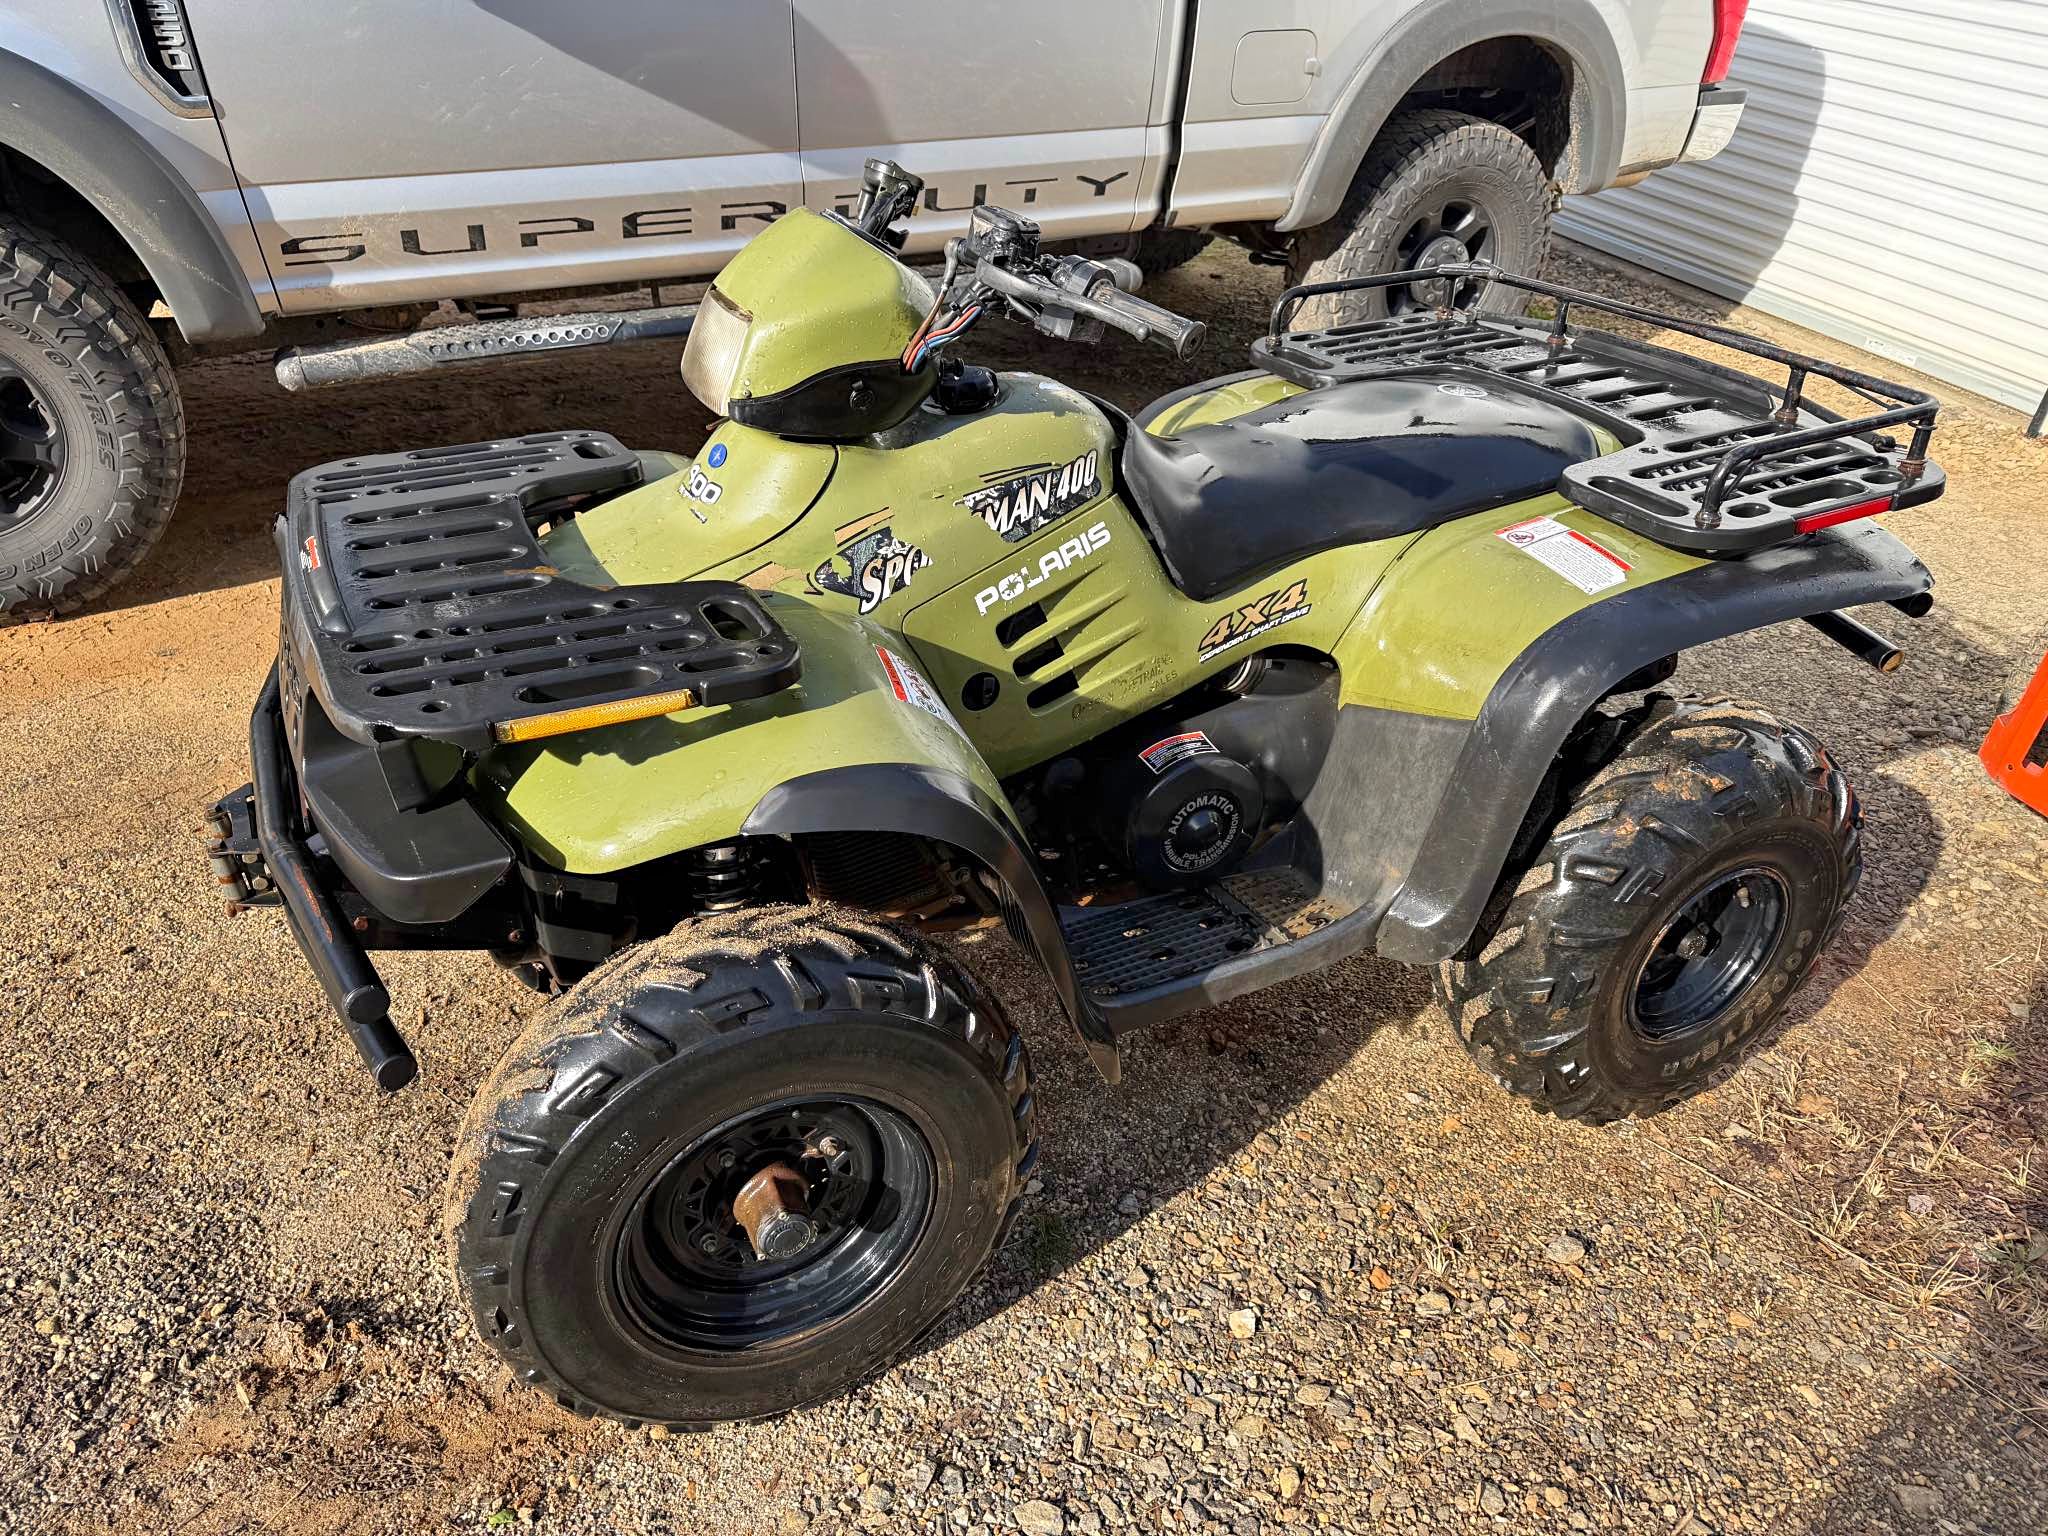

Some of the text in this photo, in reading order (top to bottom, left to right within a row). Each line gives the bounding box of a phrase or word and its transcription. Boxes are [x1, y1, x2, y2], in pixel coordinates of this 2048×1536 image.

[280, 200, 789, 267] SUPER
[0, 313, 72, 368] OYO
[66, 372, 116, 472] TIRES
[1054, 448, 1099, 502] 400
[22, 515, 93, 574] OPEN
[975, 521, 1112, 616] POLARIS
[1199, 578, 1307, 651] 4X4
[1251, 616, 1282, 638] SHAFT
[1281, 604, 1310, 623] DRIVE
[1163, 812, 1239, 868] VARIABLE TRANSMISSION
[1168, 794, 1234, 835] AUTOMATIC
[1182, 840, 1222, 860] POLARIS
